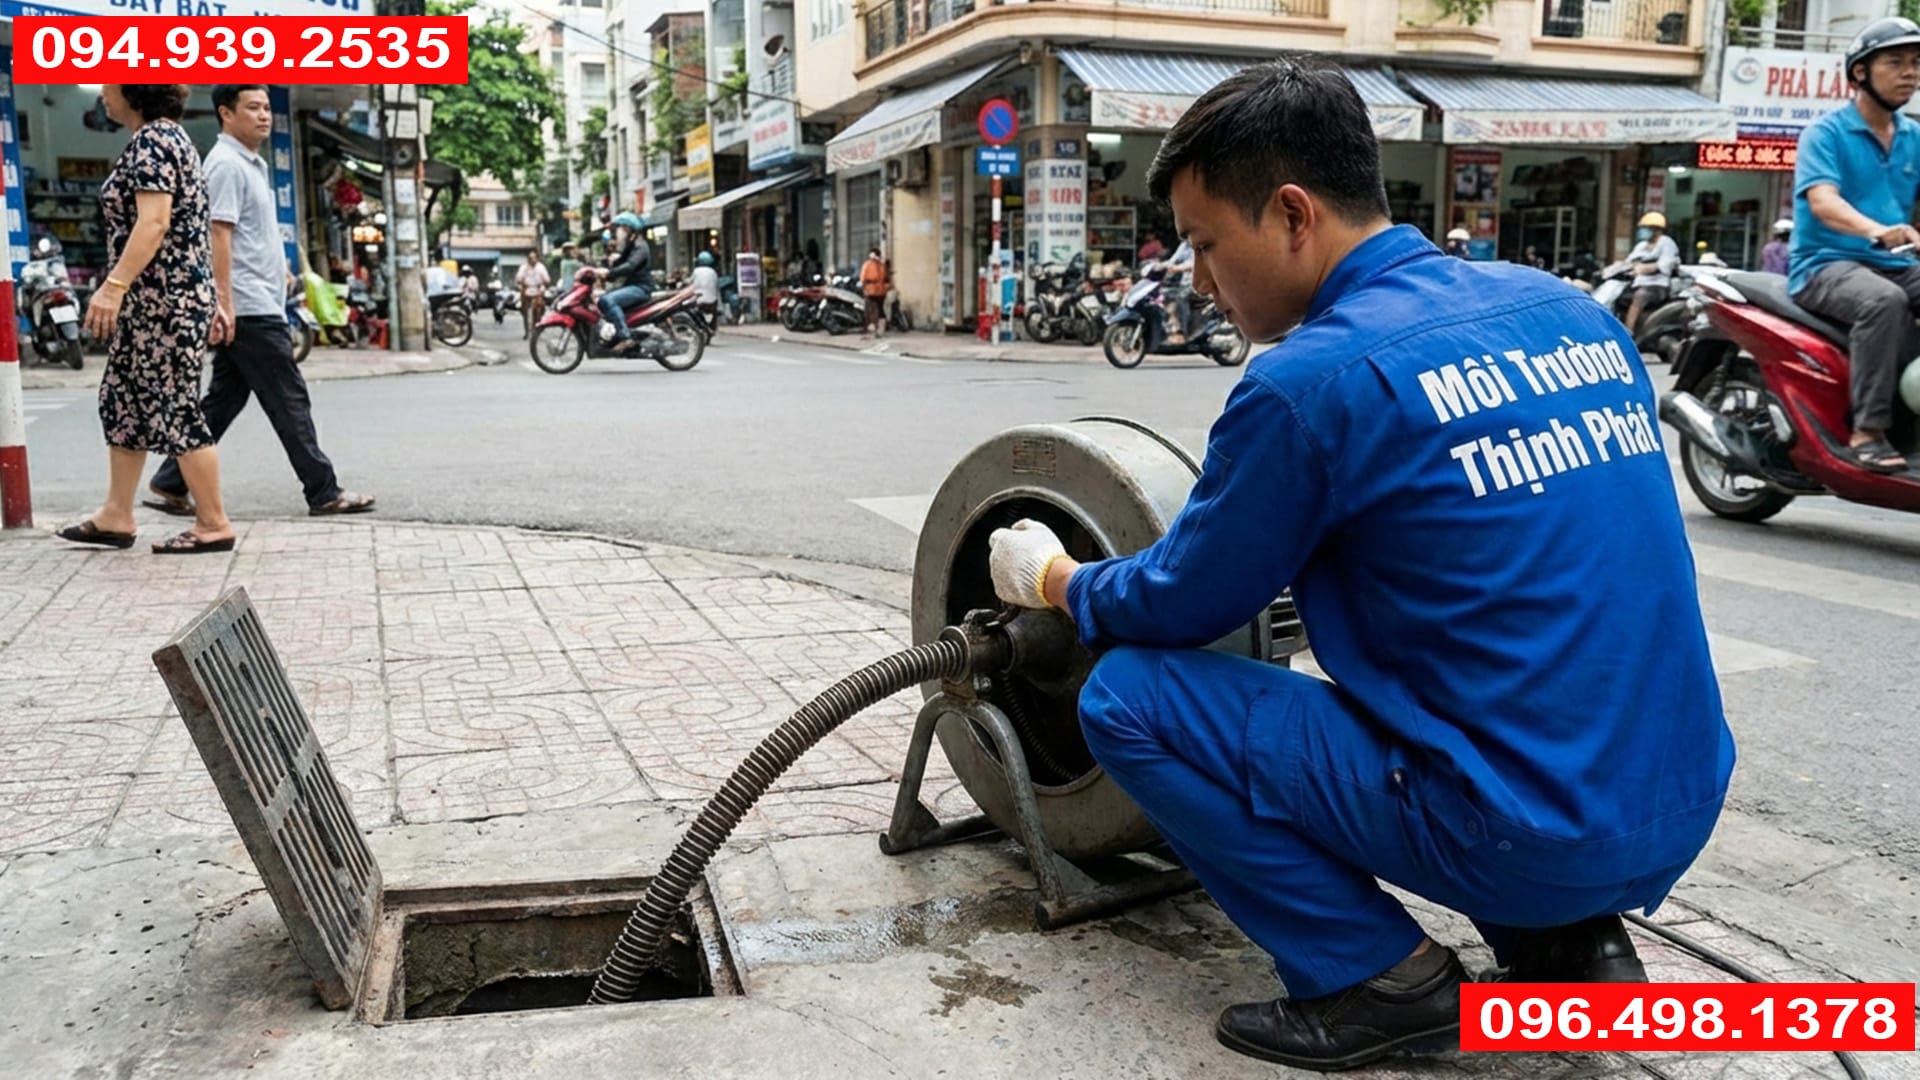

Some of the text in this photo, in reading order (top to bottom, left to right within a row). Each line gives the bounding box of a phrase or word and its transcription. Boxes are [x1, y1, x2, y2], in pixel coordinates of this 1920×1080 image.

[1417, 335, 1635, 425] Môi Trường
[1450, 400, 1661, 498] Thịnh Phát
